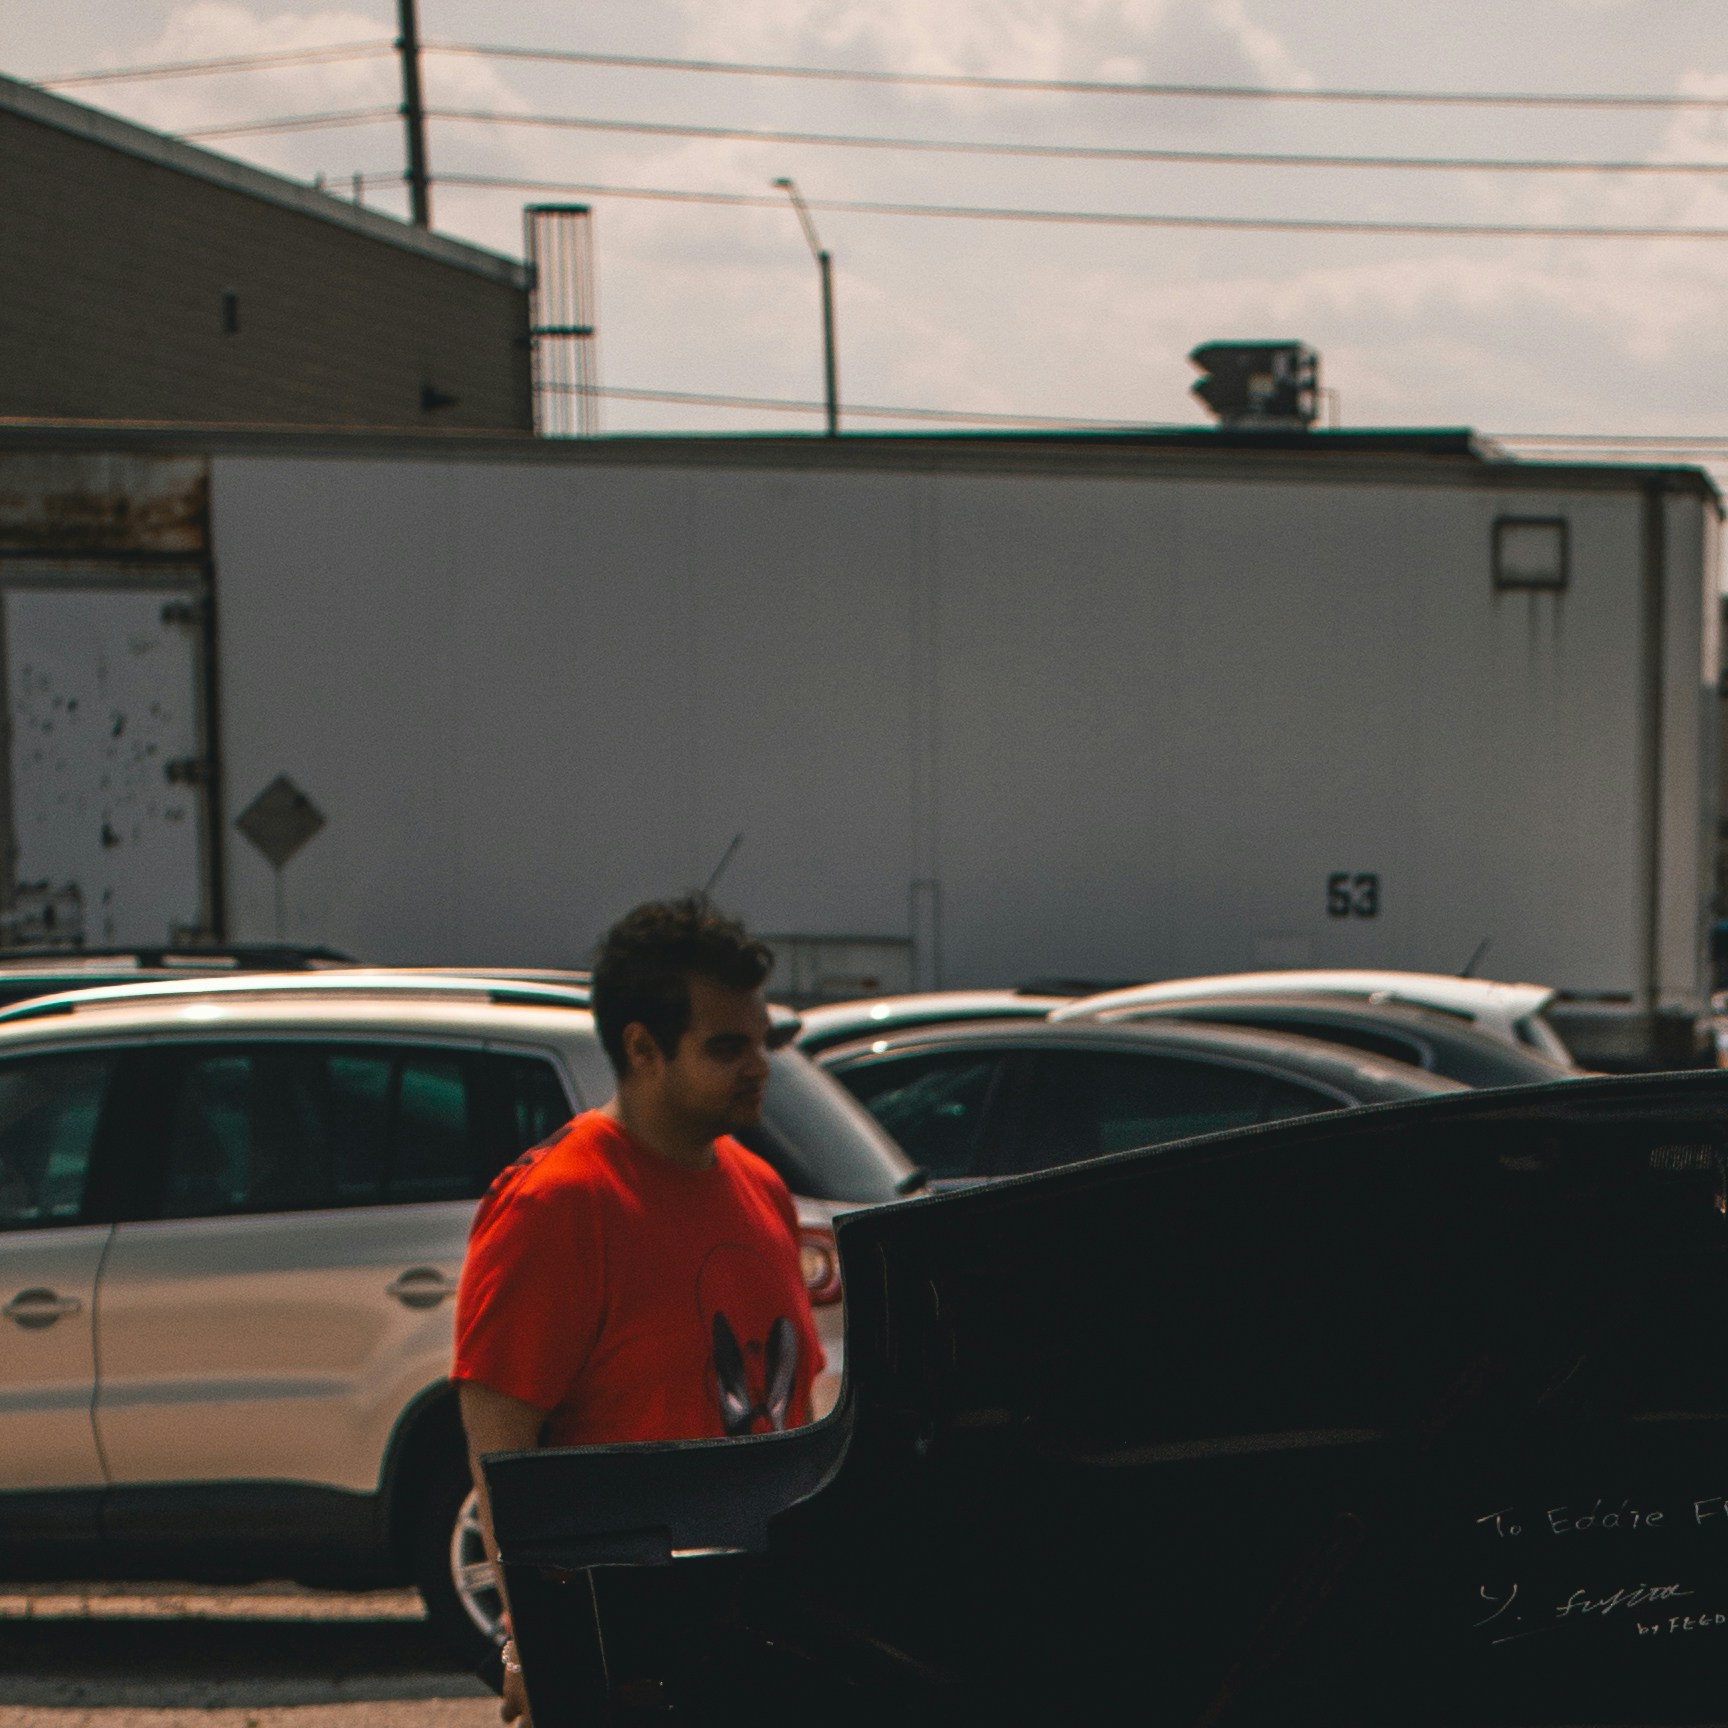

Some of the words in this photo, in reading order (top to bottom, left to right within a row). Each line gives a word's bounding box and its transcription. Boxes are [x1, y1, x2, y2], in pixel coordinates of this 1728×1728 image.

[1327, 871, 1379, 918] 53
[1475, 1506, 1523, 1538] To
[1547, 1499, 1666, 1535] Eddie
[1668, 1613, 1727, 1634] FEED
